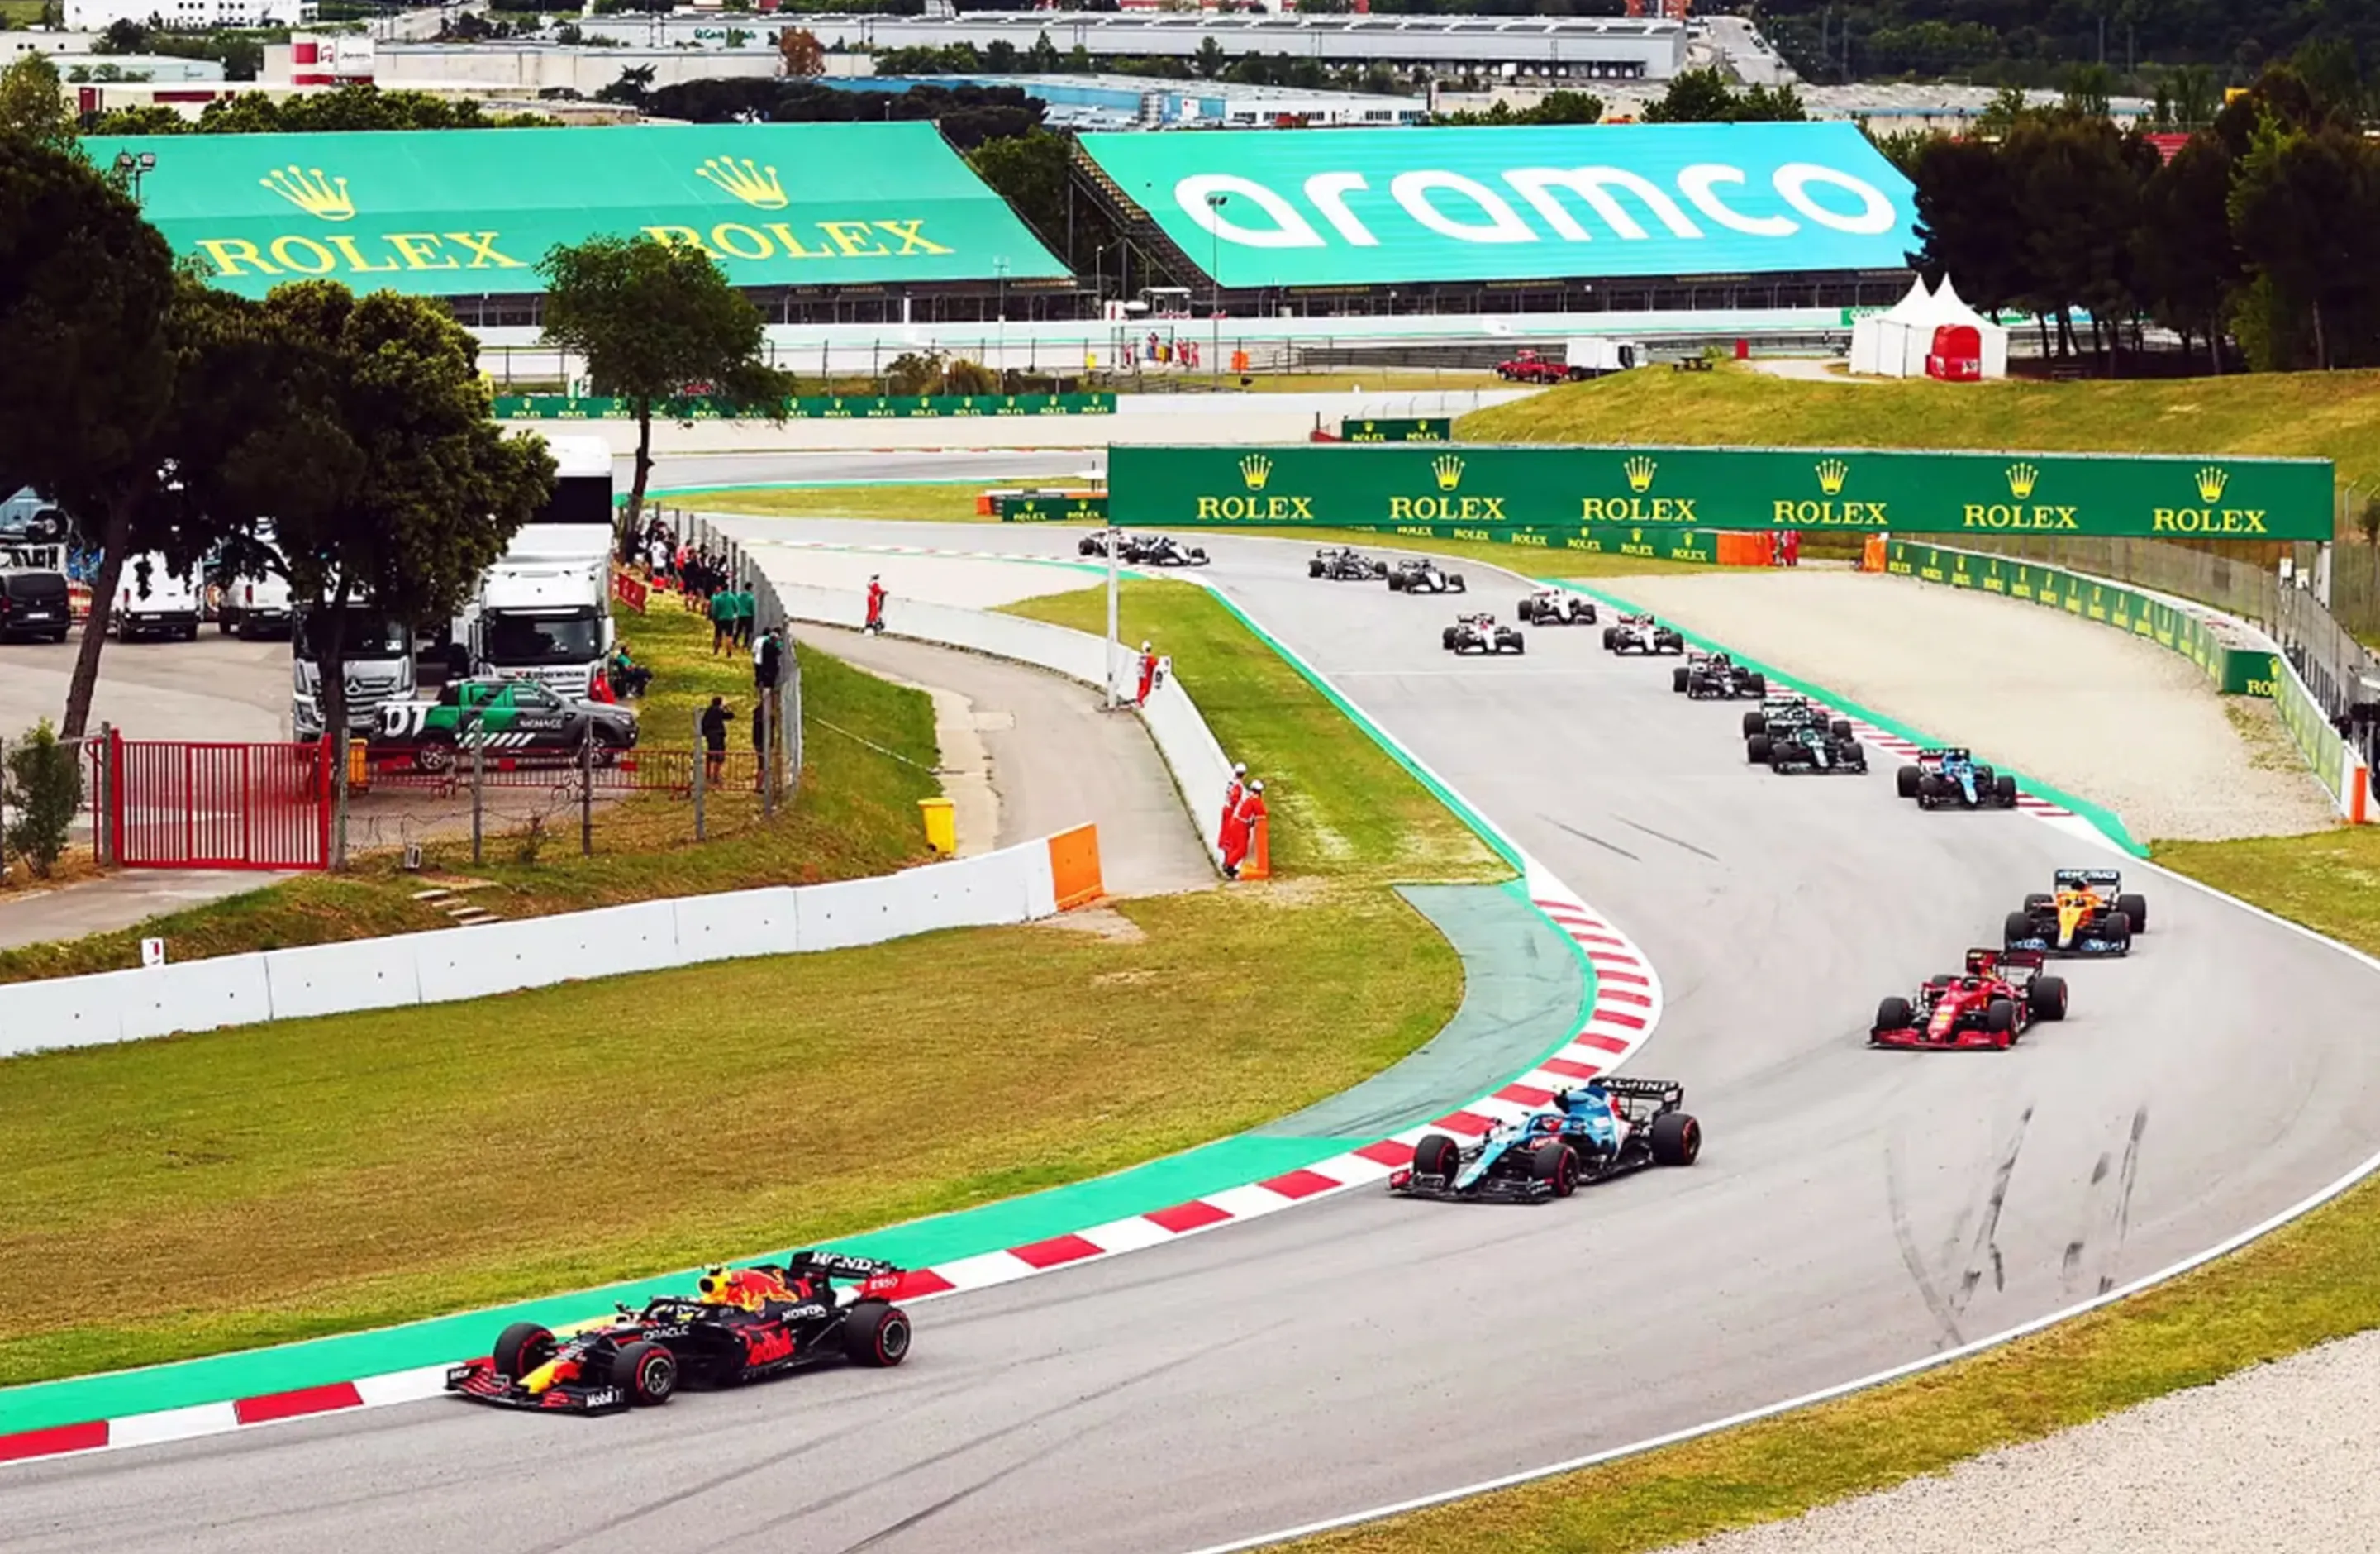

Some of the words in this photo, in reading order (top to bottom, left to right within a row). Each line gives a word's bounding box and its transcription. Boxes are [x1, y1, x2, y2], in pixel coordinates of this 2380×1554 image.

[1174, 162, 1896, 247] aramco
[640, 219, 955, 261] ROLEX
[195, 231, 529, 277] ROLEX
[1197, 497, 1313, 520] ROLEX
[1390, 497, 1506, 520] ROLEX
[1582, 498, 1697, 522] ROLEX
[1773, 500, 1888, 525] ROLEX
[1964, 504, 2078, 529] ROLEX
[2153, 508, 2268, 533] ROLEX
